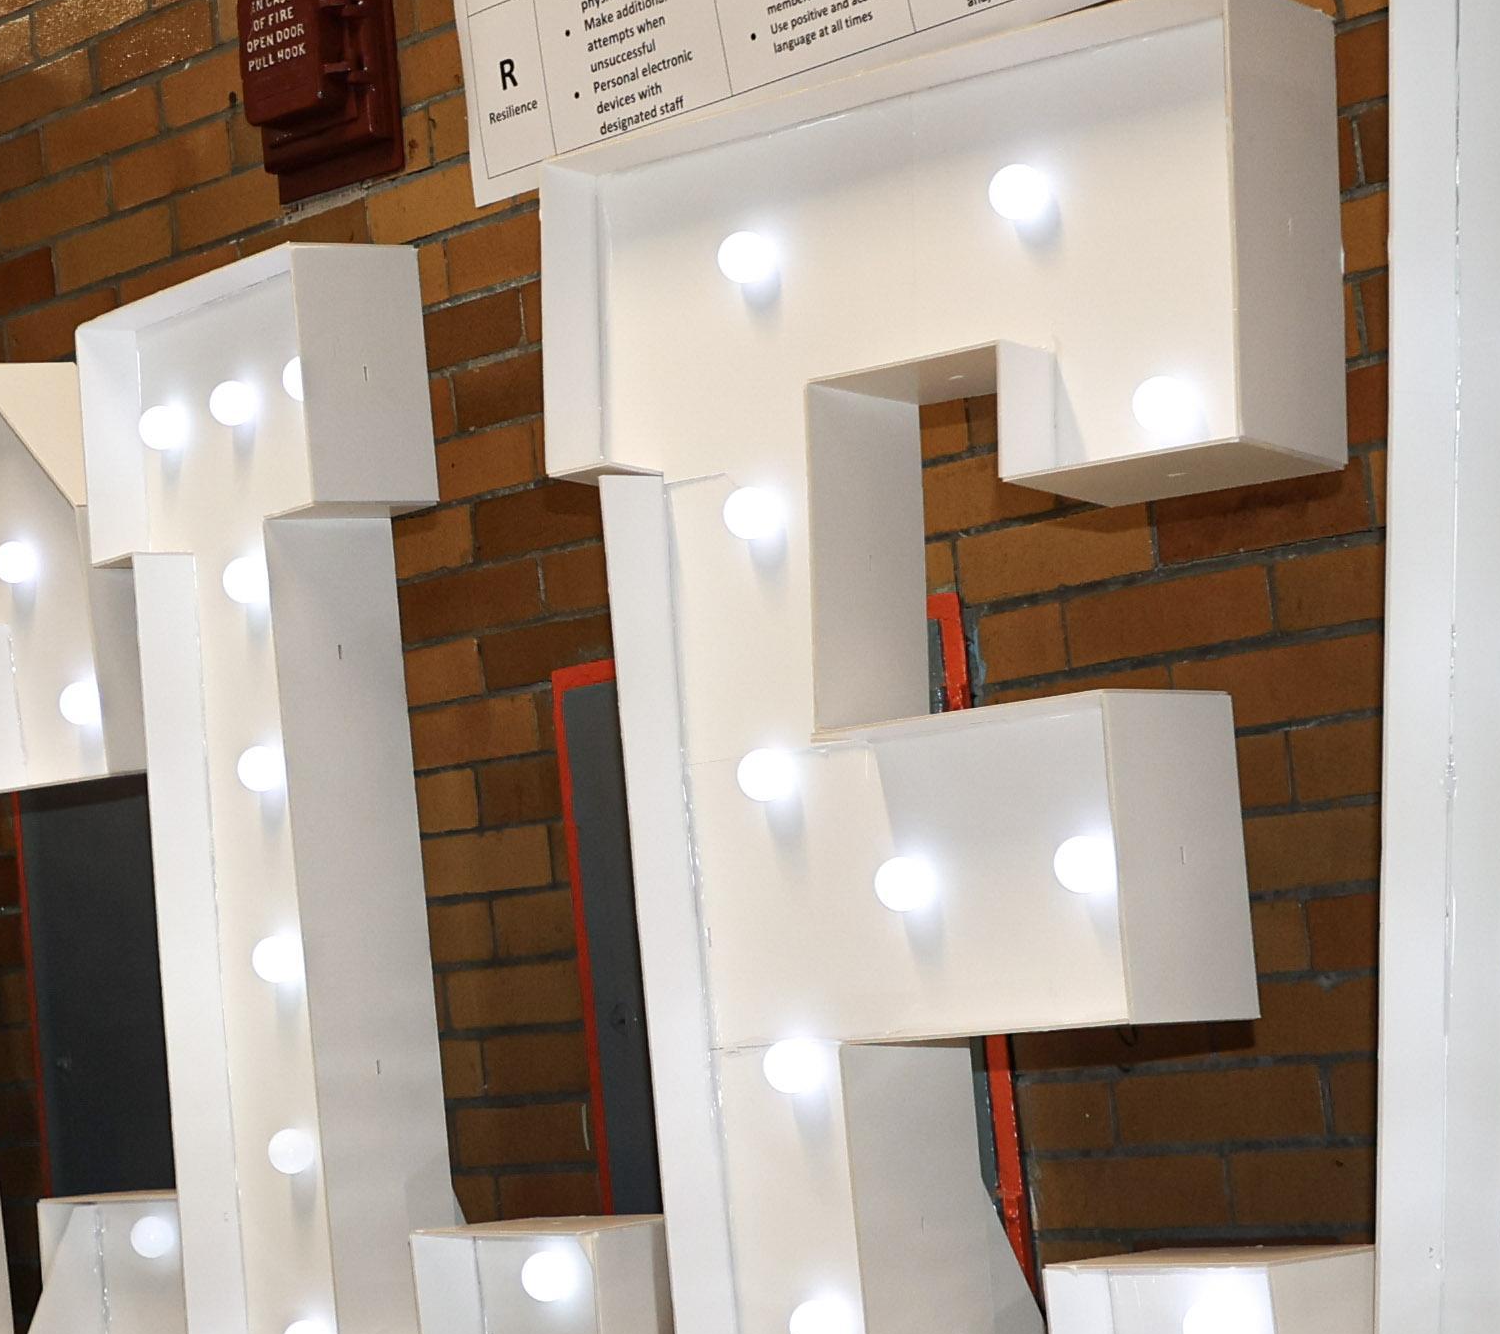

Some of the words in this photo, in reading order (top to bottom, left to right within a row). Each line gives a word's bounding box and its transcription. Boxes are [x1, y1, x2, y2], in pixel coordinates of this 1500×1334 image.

[251, 0, 264, 13] IN
[253, 18, 266, 33] OF
[268, 6, 295, 28] FIRE
[582, 12, 614, 31] Make
[247, 33, 275, 53] OPEN
[276, 23, 305, 44] DOOR
[586, 26, 635, 52] attempts
[634, 15, 666, 34] when
[248, 54, 275, 72] PULL
[277, 42, 306, 62] HOOK
[589, 38, 657, 73] unsuccessful
[591, 66, 640, 93] Personal
[640, 49, 694, 77] electronic
[498, 58, 519, 91] R
[487, 99, 538, 124] Resilience
[595, 93, 637, 114] devices
[636, 82, 663, 100] with
[598, 104, 658, 135] designated
[658, 94, 684, 115] staff
